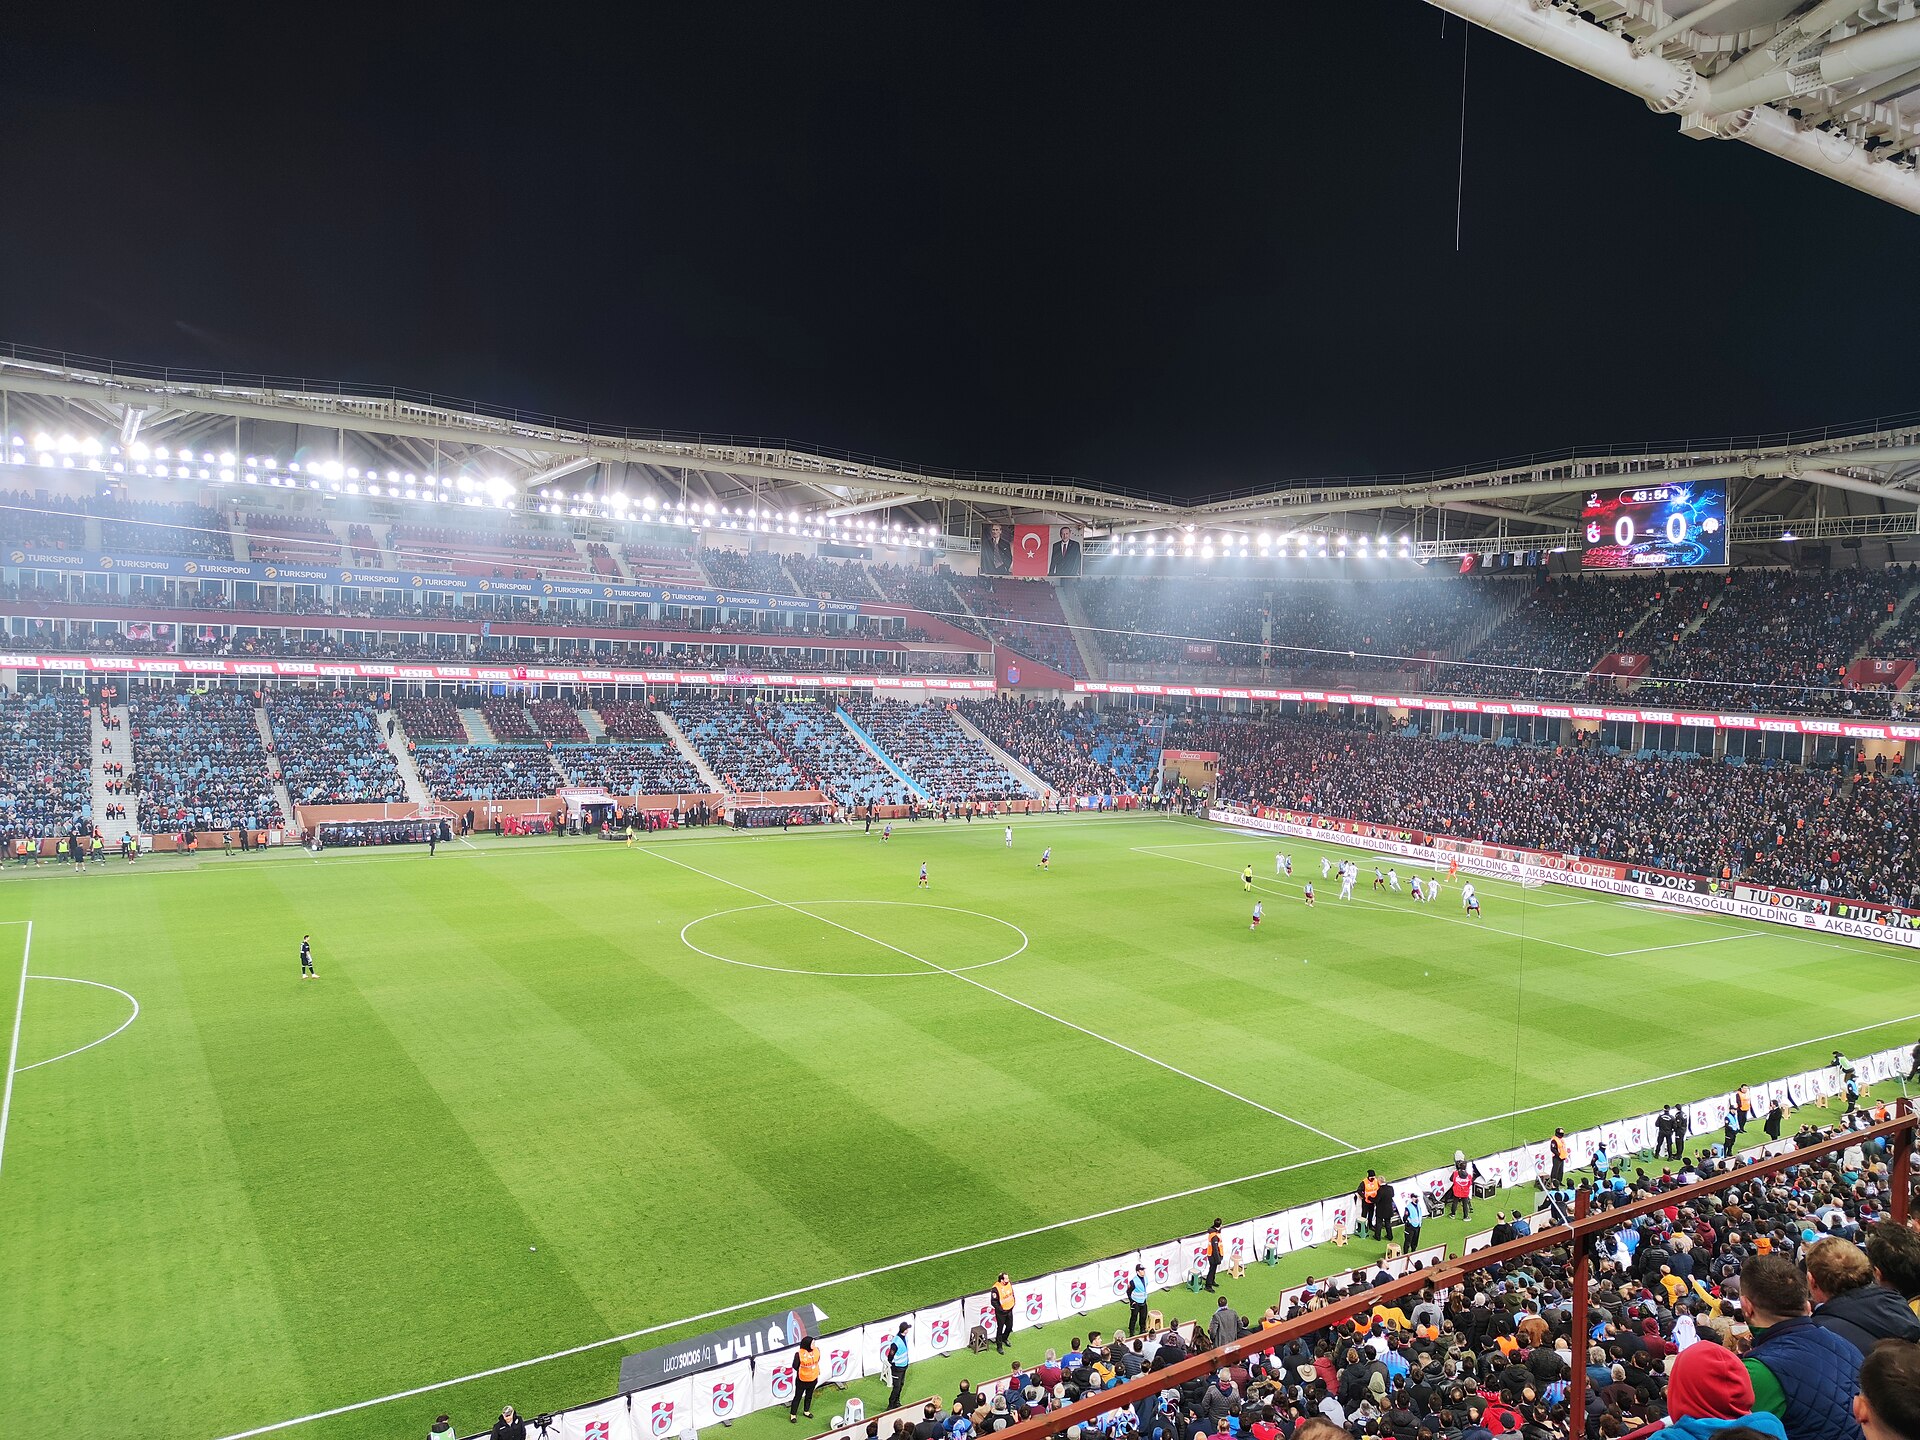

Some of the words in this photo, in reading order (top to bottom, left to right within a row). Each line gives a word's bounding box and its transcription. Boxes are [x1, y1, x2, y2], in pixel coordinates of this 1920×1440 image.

[1632, 489, 1668, 501] 43:54
[1615, 516, 1634, 546] 0
[1666, 513, 1687, 543] 0
[42, 660, 88, 670] VESTEL
[91, 658, 136, 668] VESTEL
[138, 662, 180, 672] VESTEL
[184, 660, 227, 671] VESTEL
[234, 664, 273, 674] VESTEL
[277, 662, 317, 672] VESTEL
[320, 667, 356, 676] VESTEL
[360, 665, 396, 674] VESTEL
[398, 668, 434, 678] VESTEL
[437, 668, 472, 677] VESTEL
[476, 671, 511, 680] VESTEL
[548, 672, 579, 681] VESTEL
[581, 670, 612, 680] VESTEL
[614, 674, 645, 683] VESTEL
[646, 672, 676, 682] VESTEL
[679, 676, 710, 684] VESTEL
[768, 676, 795, 684] VESTEL
[822, 677, 847, 686] VESTEL
[877, 678, 901, 686] VESTEL
[972, 680, 994, 688] VESTEL
[1136, 684, 1162, 692] VESTEL
[1194, 687, 1221, 695] VESTEL
[1250, 690, 1279, 698] VESTEL
[1302, 691, 1324, 700] VESTEL
[1350, 694, 1374, 703] VESTEL
[1375, 698, 1398, 706] VESTEL
[1399, 698, 1424, 706] VESTEL
[1424, 702, 1450, 710] VESTEL
[1451, 700, 1478, 710] VESTEL
[1481, 705, 1510, 714] VESTEL
[1511, 704, 1540, 714] VESTEL
[1542, 708, 1571, 718] VESTEL
[1572, 707, 1603, 717] VESTEL
[1605, 712, 1639, 721] VESTEL
[1640, 710, 1674, 722] VESTEL
[1680, 716, 1716, 727] VESTEL
[1718, 716, 1756, 727] VESTEL
[1759, 721, 1799, 732] VESTEL
[1800, 720, 1842, 732] VESTEL
[1844, 727, 1888, 738] VESTEL
[1572, 860, 1616, 880] COFFEE
[1662, 890, 1734, 912] AKBAŞOĞLU
[1740, 904, 1798, 923] HOLDİNG
[1824, 919, 1913, 944] AKBAŞOĞLU
[663, 1349, 701, 1373] socios.com
